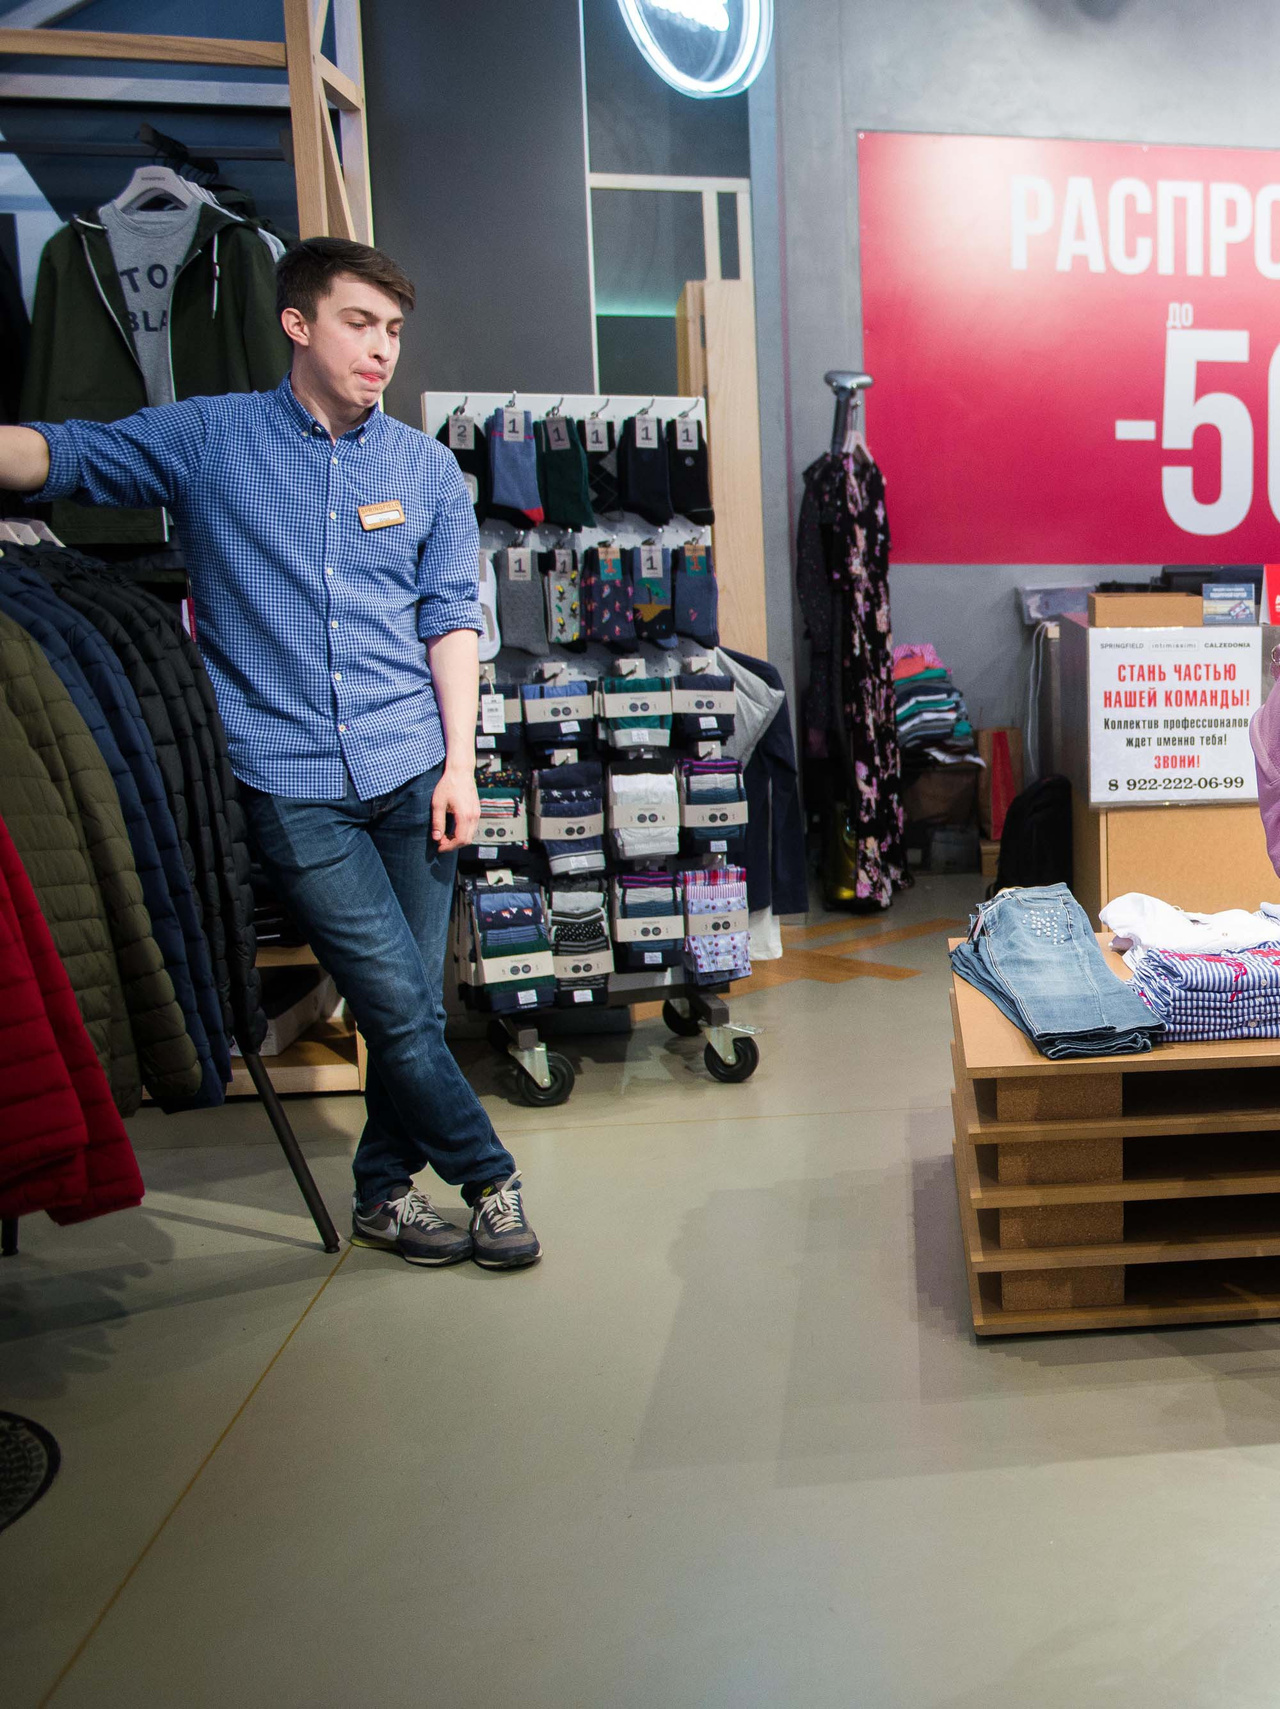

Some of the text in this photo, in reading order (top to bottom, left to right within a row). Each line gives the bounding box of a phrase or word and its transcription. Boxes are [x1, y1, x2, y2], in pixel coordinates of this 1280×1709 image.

[1166, 302, 1194, 328] ДО
[457, 424, 468, 438] 2
[508, 418, 519, 434] 1
[553, 426, 565, 442] 1
[641, 426, 652, 441] 1
[591, 428, 603, 445] 1
[682, 427, 693, 443] 1
[1117, 663, 1236, 682] СТАНЬ ЧАСТЬЮ
[1103, 687, 1250, 709] НАШЕЙ КОМАНДЫ!
[1104, 717, 1249, 731] Коллектив профессионалов
[1126, 734, 1227, 748] ждет именно тебя!
[1154, 755, 1200, 769] ЗВОНИ!
[1108, 776, 1244, 791] 8 922-222-06-99
